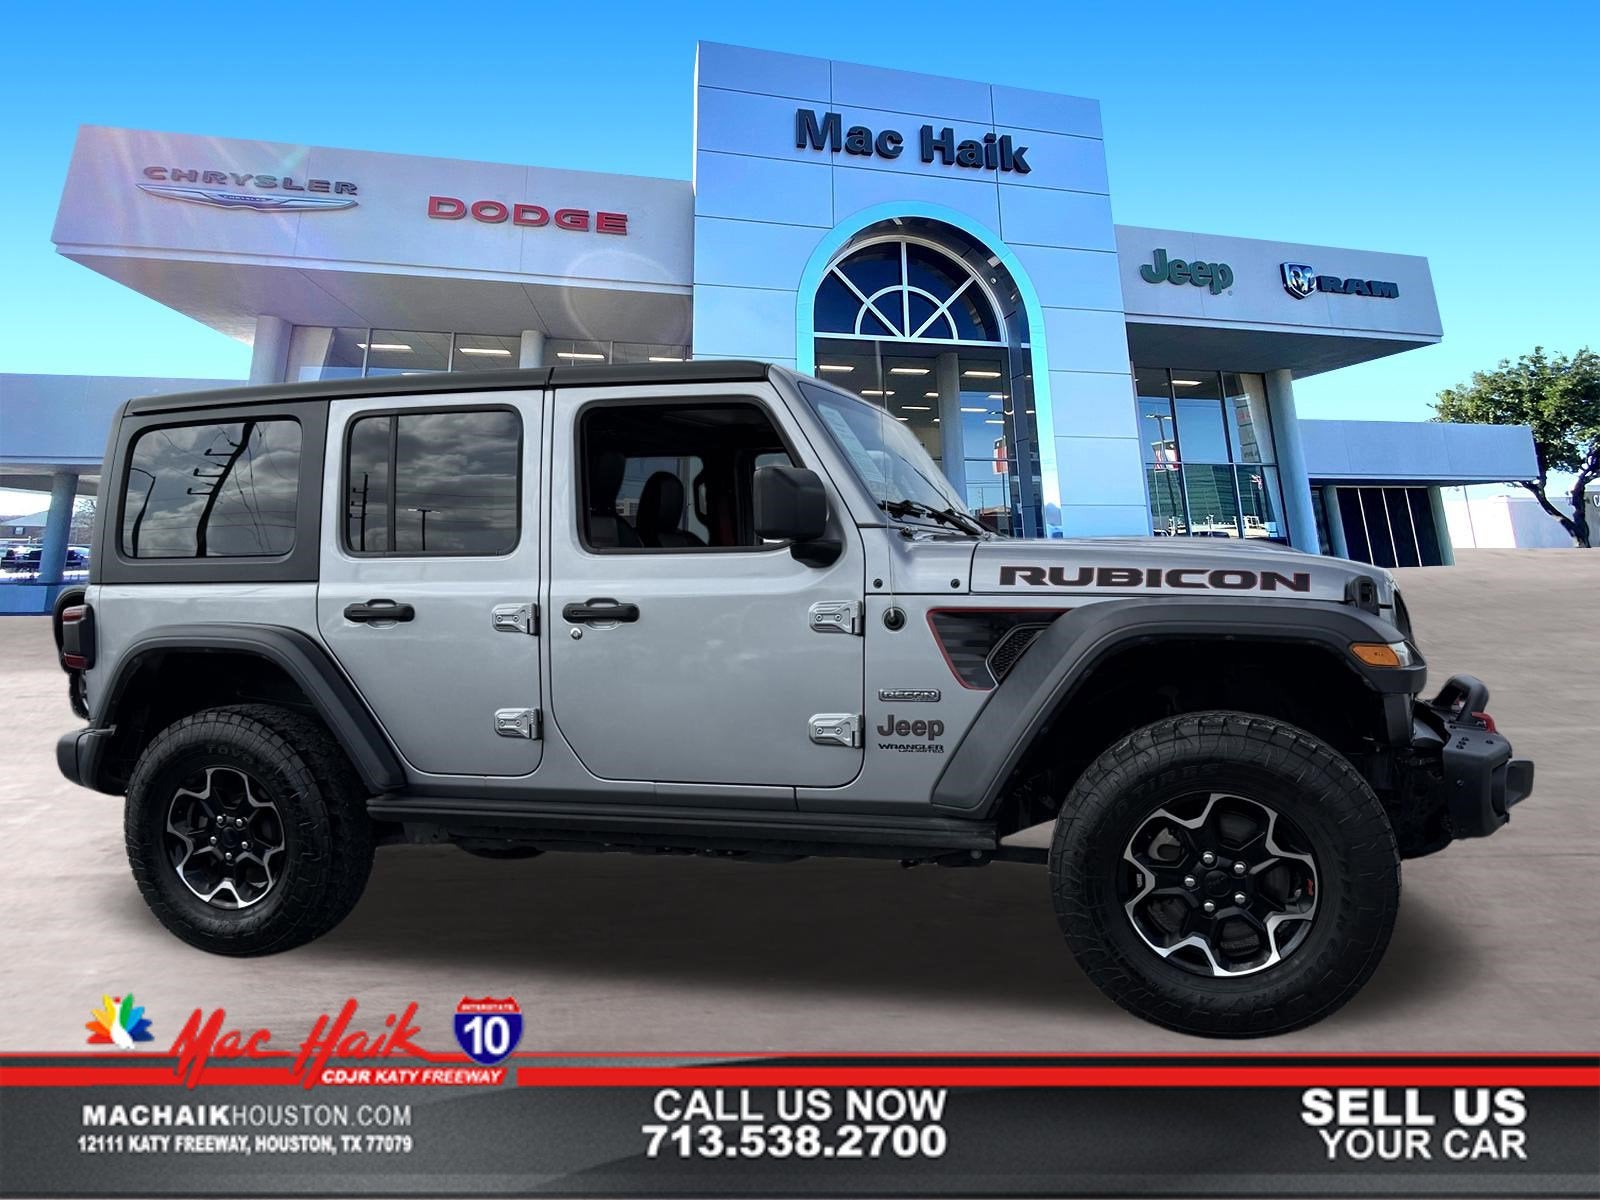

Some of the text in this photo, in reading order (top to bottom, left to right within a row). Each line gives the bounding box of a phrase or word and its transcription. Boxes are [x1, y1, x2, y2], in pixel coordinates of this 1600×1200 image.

[796, 108, 1032, 174] Mac Haik
[143, 166, 358, 196] CHRYSLER
[427, 195, 628, 236] DODGE
[1139, 248, 1234, 296] Jeep
[1316, 275, 1400, 299] RAM
[999, 565, 1311, 593] RUBICON
[877, 714, 945, 741] Jeep
